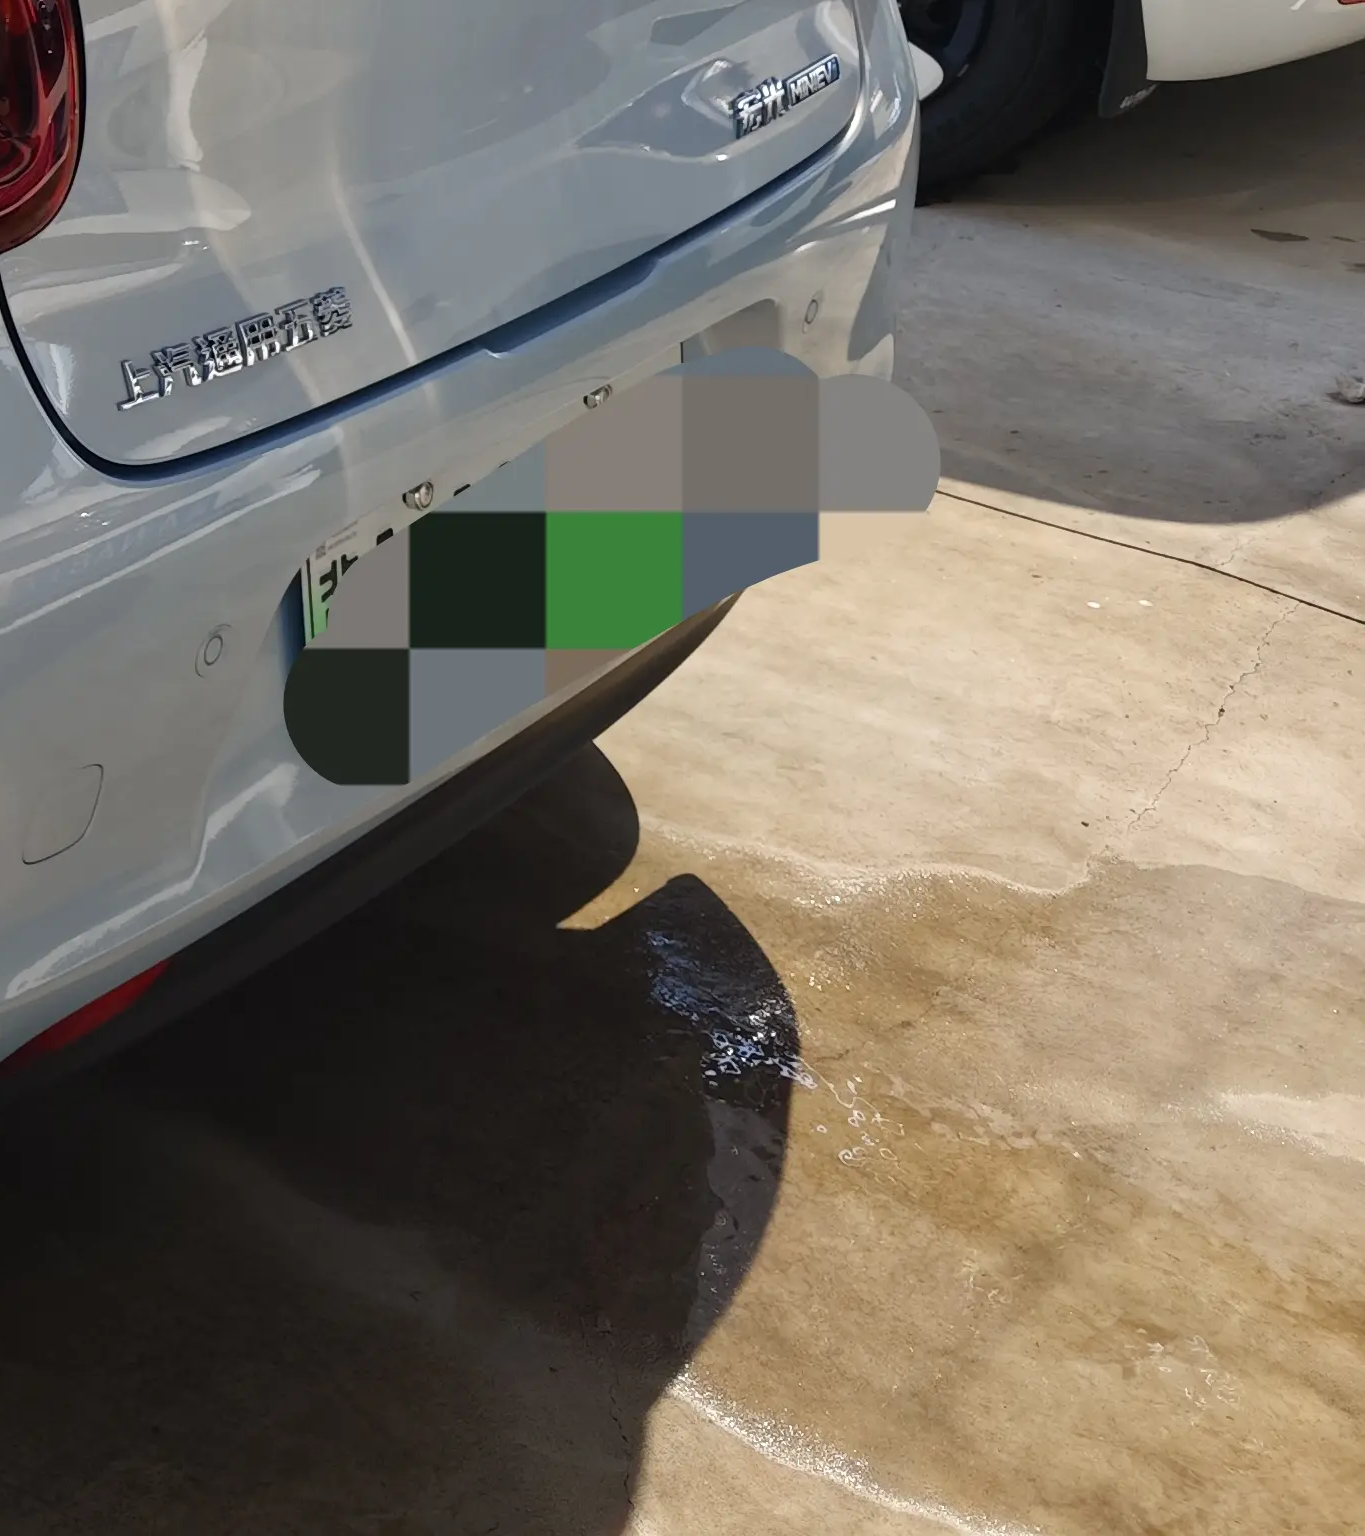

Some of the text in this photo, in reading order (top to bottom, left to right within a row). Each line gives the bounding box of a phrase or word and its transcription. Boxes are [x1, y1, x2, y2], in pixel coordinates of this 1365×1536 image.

[116, 286, 353, 412] 上汽通用五菱
